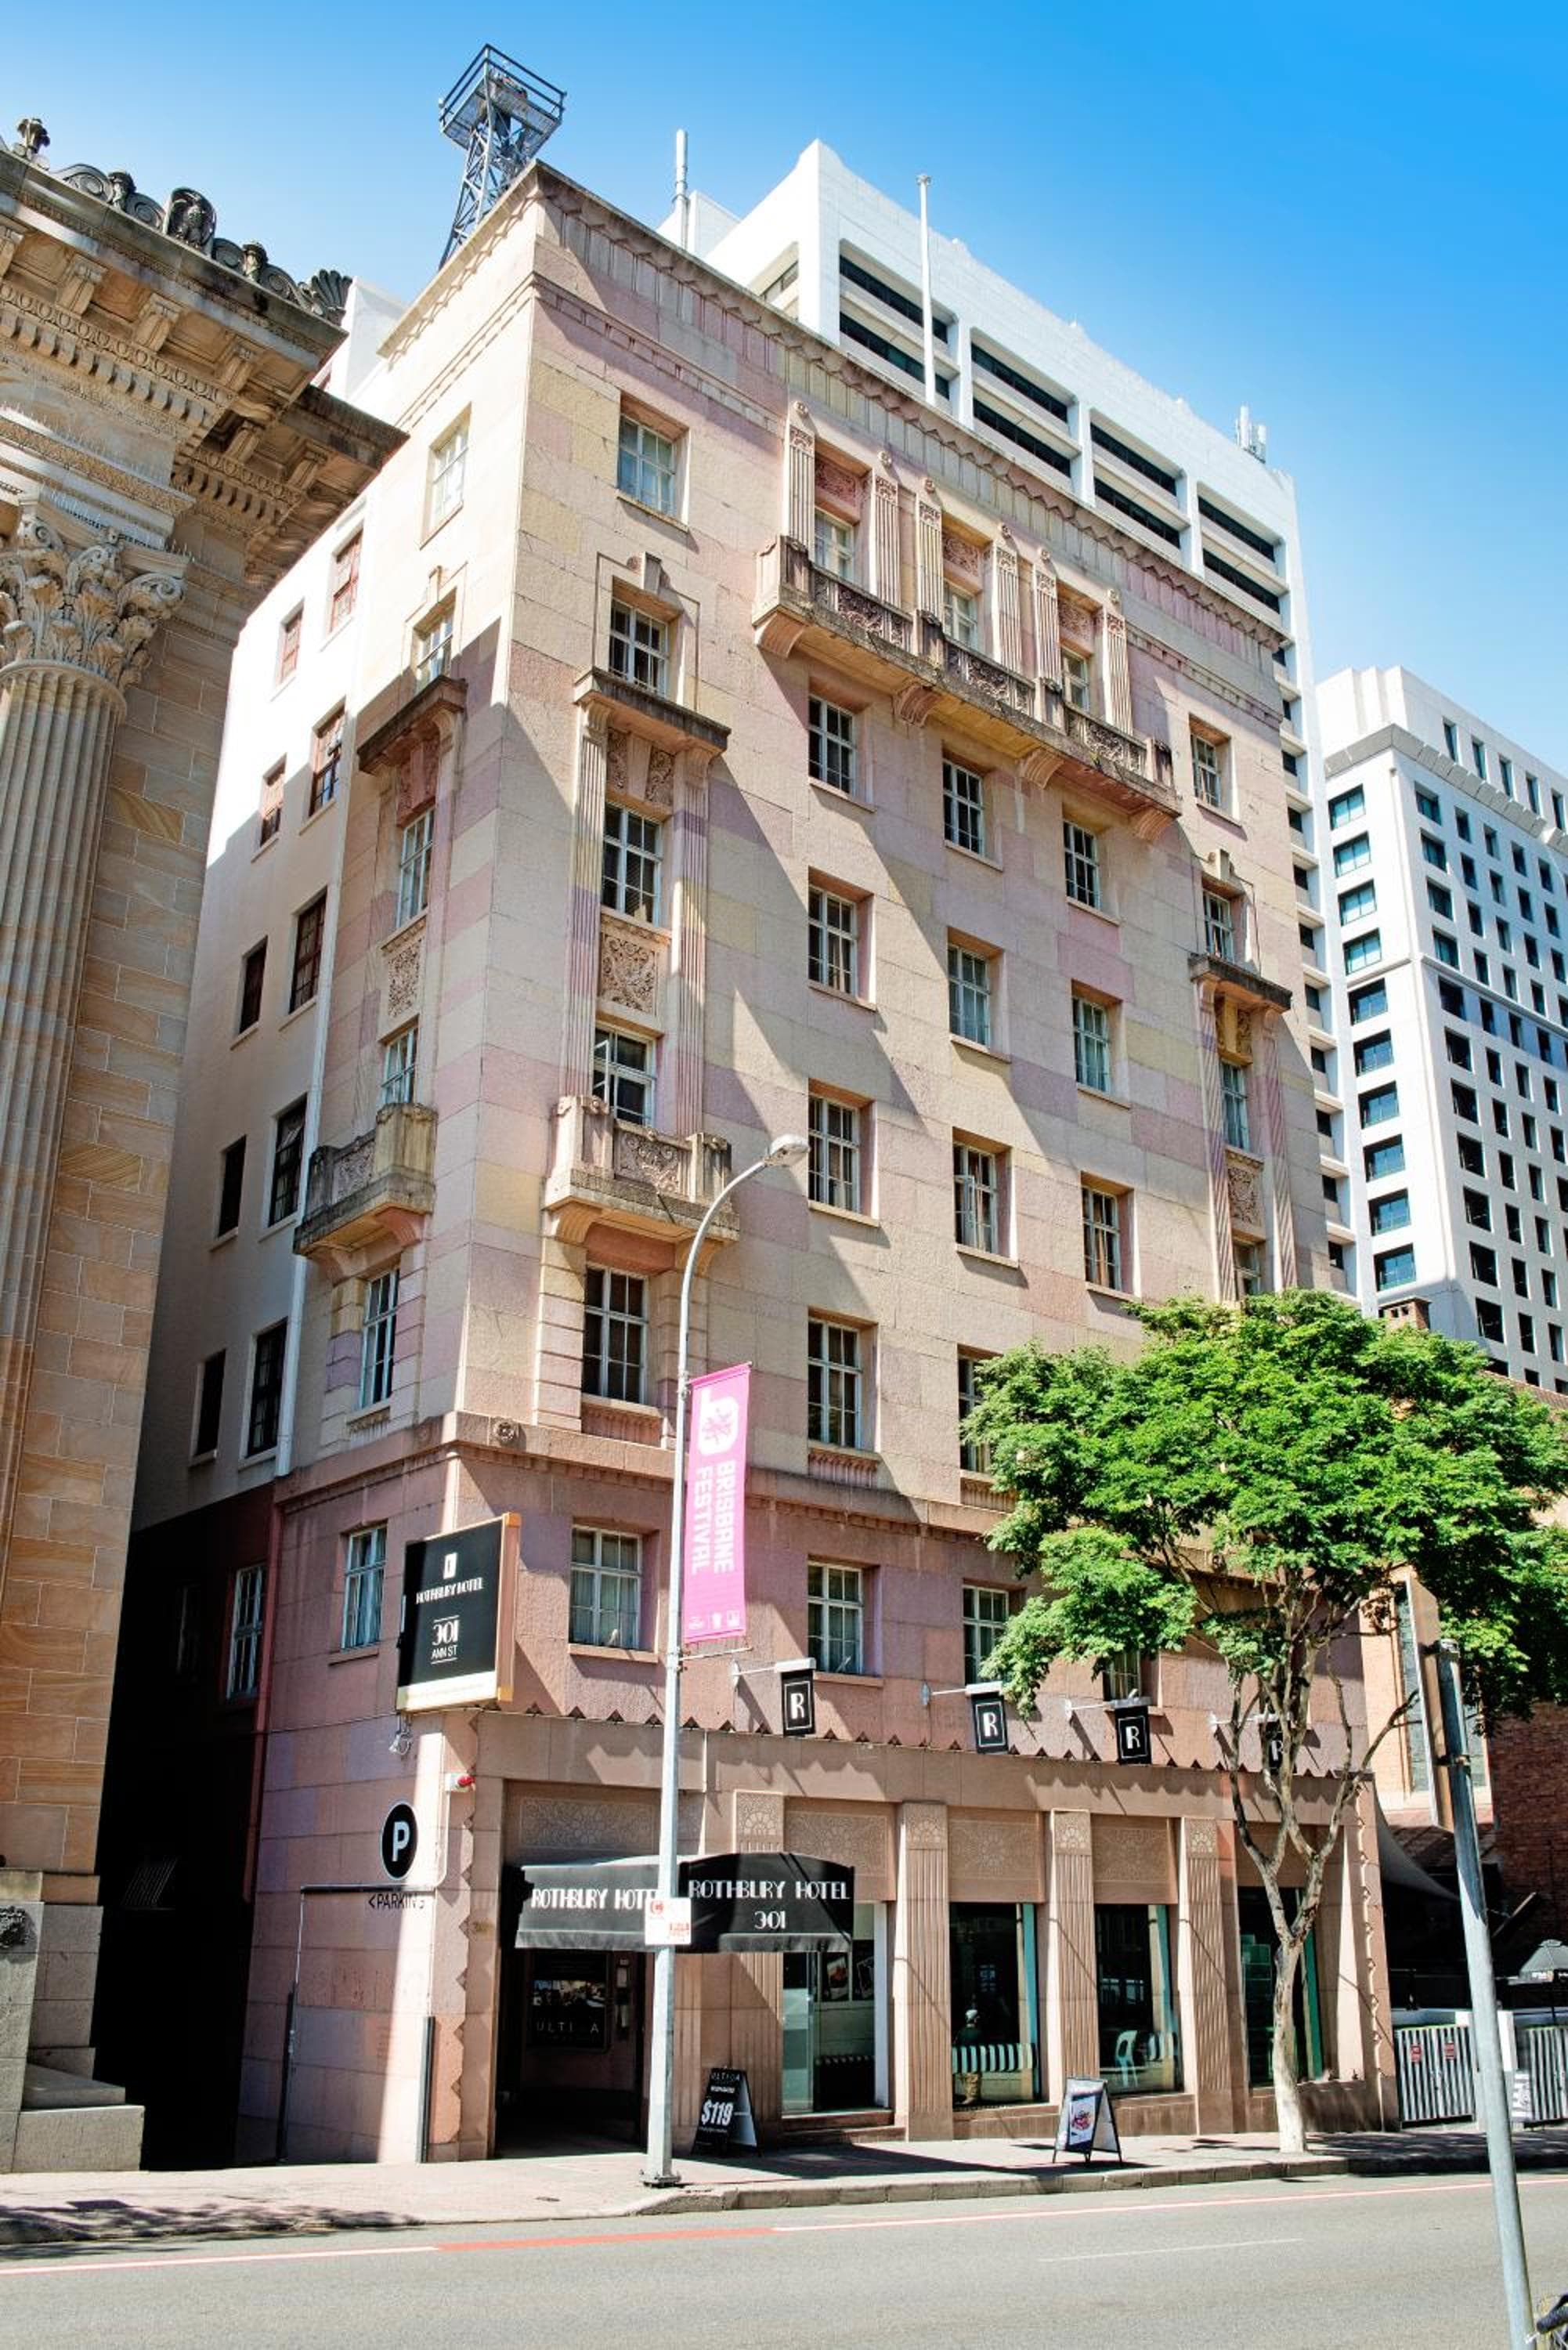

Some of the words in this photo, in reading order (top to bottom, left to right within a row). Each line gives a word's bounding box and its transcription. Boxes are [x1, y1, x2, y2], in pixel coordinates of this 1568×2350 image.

[692, 1466, 714, 1575] FESTIVAL
[714, 1459, 736, 1574] BRISBANE
[457, 1577, 483, 1595] HOTEL
[432, 1619, 460, 1646] 301
[431, 1647, 447, 1659] ANN
[447, 1644, 458, 1657] ST
[790, 1693, 805, 1719] R
[983, 1712, 999, 1737] R
[1125, 1726, 1141, 1749] R
[392, 1820, 410, 1863] P
[530, 1888, 609, 1910] ROTHBURY
[614, 1889, 659, 1911] HOT
[688, 1879, 786, 1900] ROTHBURY
[794, 1881, 851, 1900] HOTEL
[753, 1911, 786, 1929] 301
[536, 2021, 600, 2035] ULTIA
